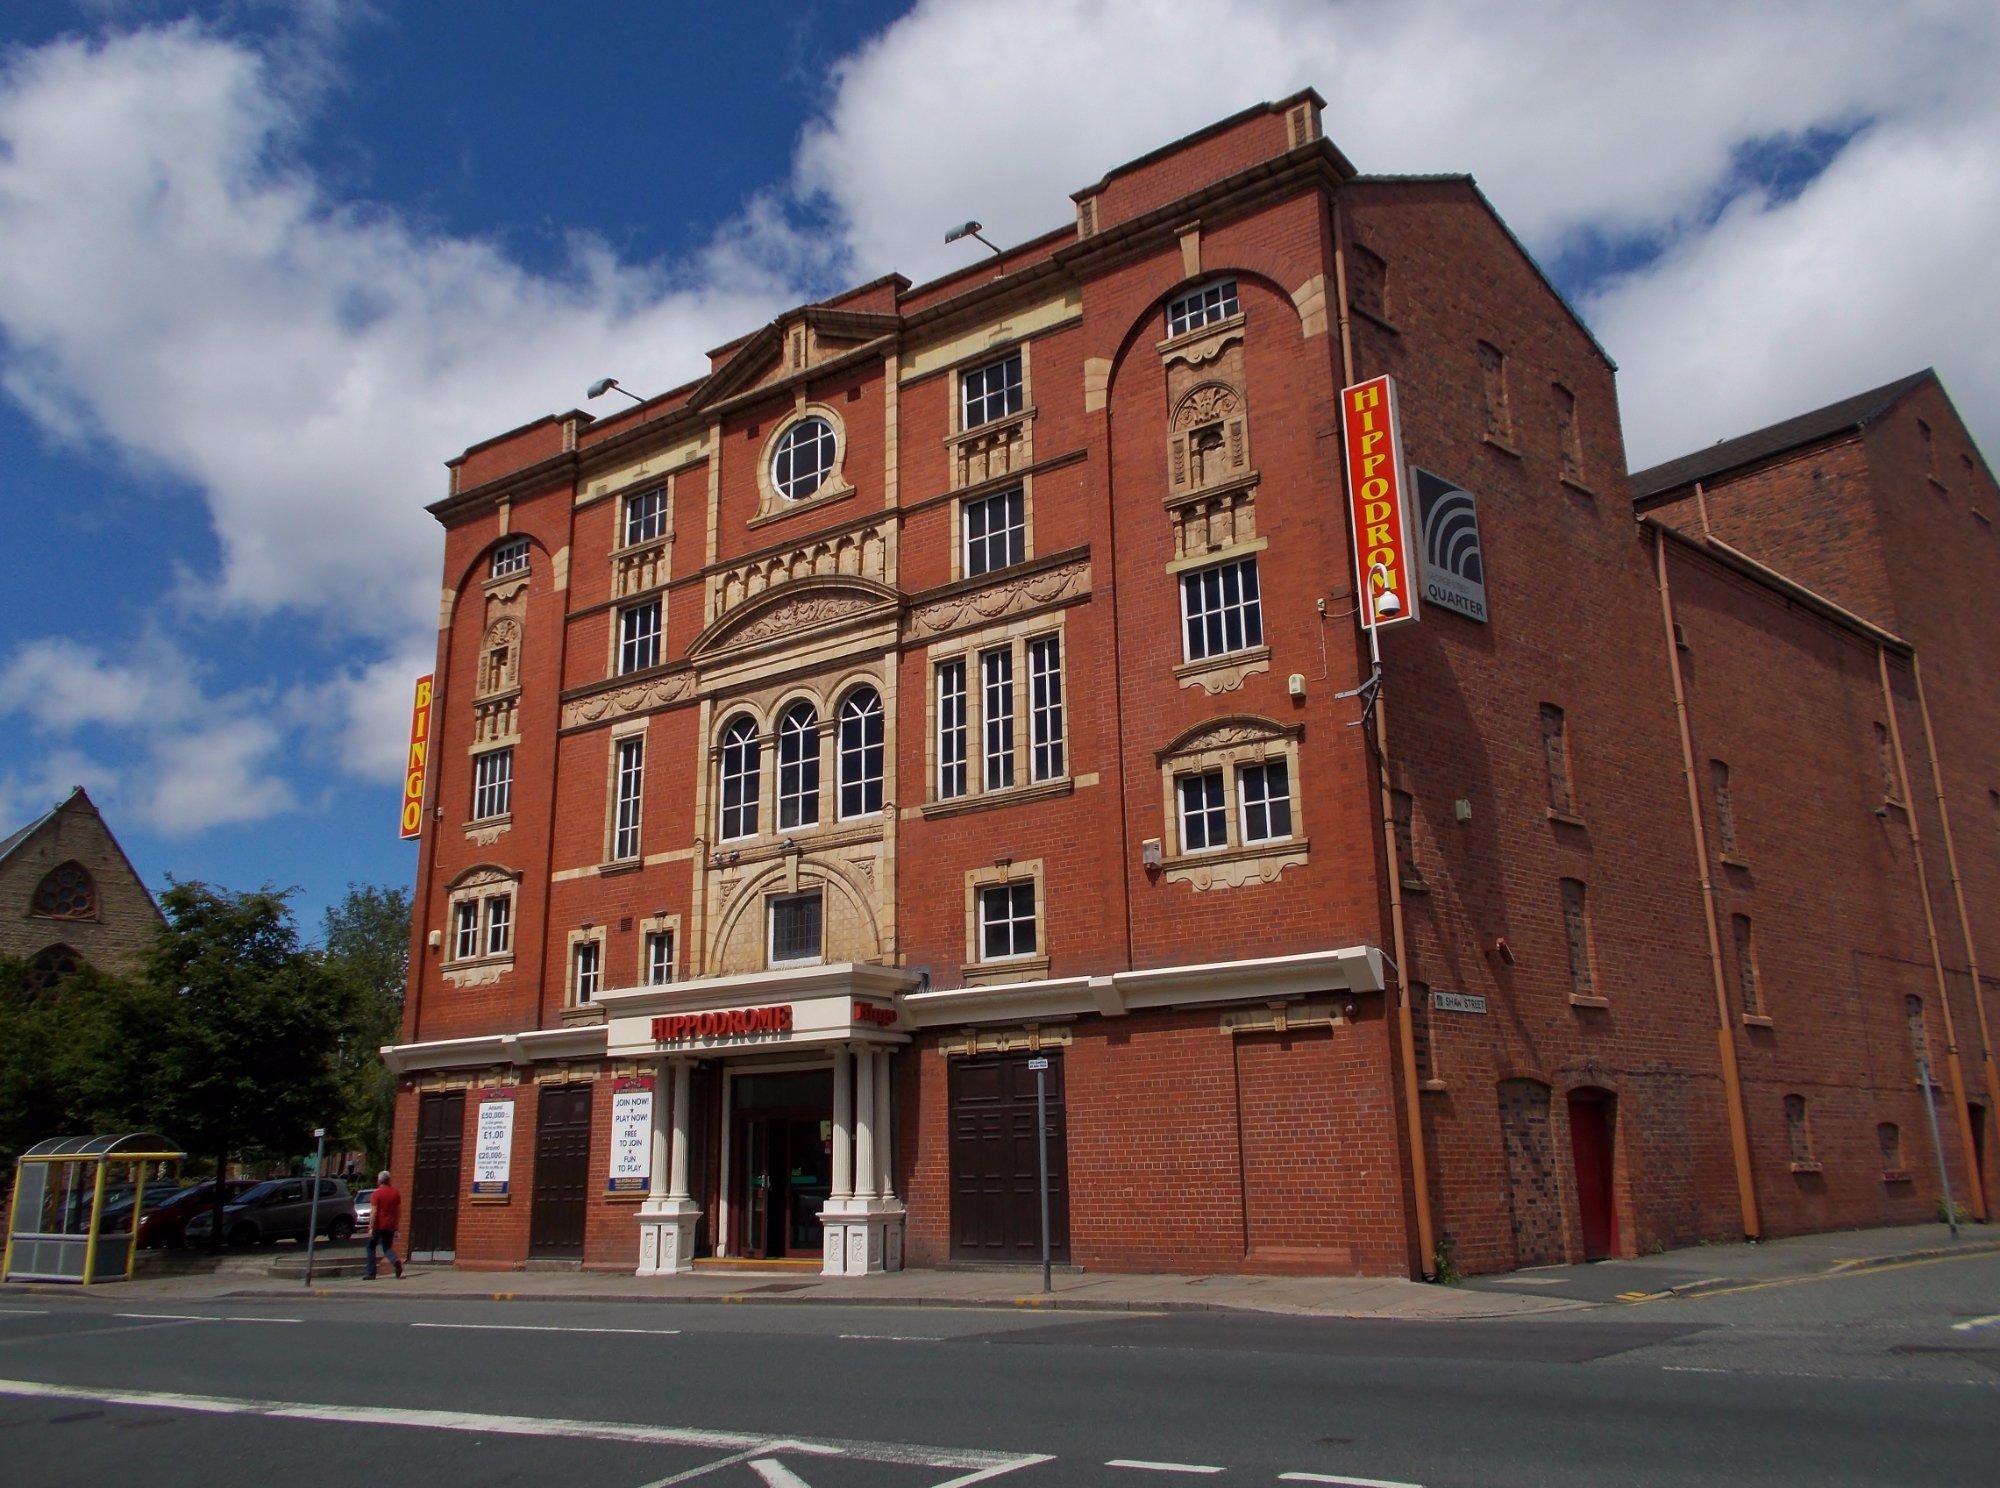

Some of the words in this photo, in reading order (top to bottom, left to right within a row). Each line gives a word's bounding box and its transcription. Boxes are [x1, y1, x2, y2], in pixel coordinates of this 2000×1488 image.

[1428, 583, 1484, 616] QUARTER
[403, 681, 431, 831] BINGO
[1464, 998, 1484, 1010] STREET
[650, 1004, 793, 1041] HIPPODROME
[616, 1099, 630, 1107] JOIN
[616, 1115, 630, 1123] PLAY
[628, 1139, 643, 1147] JOIN
[618, 1165, 626, 1173] TO
[627, 1164, 641, 1172] PLAY
